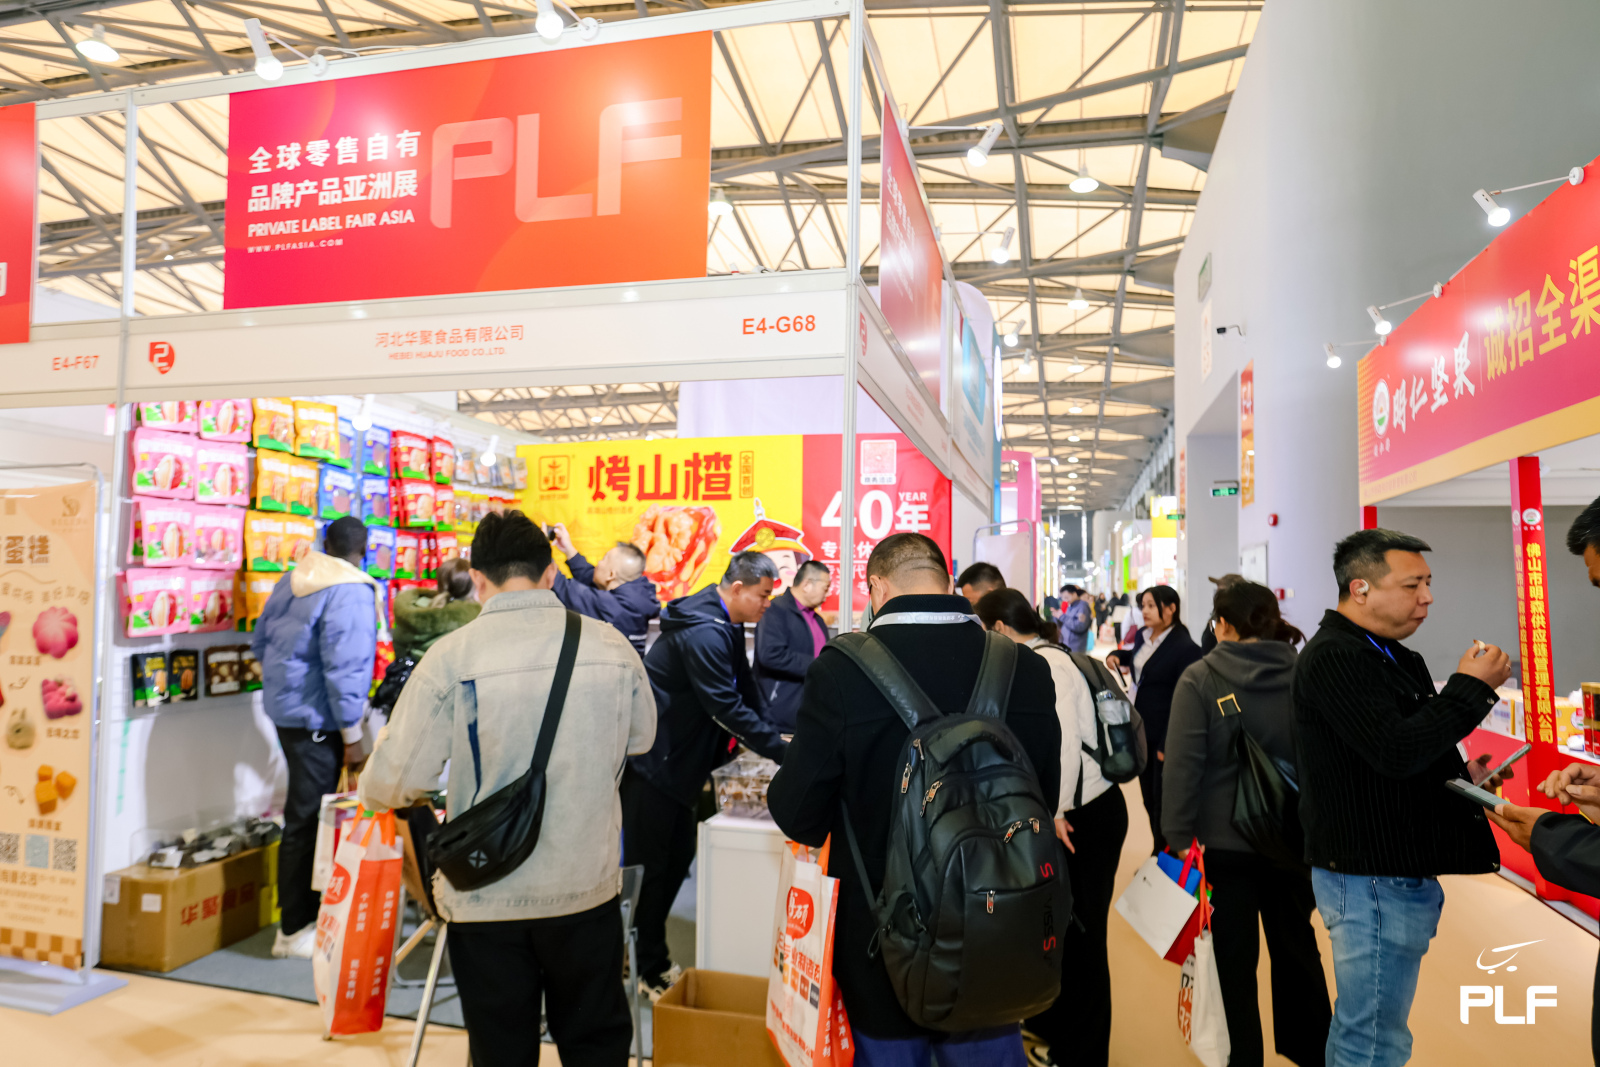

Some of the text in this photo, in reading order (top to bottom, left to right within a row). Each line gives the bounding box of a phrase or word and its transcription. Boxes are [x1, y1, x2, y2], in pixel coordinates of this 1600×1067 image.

[248, 129, 421, 174] 全球零售自有
[430, 97, 683, 229] PLF
[248, 169, 418, 212] 品牌产品亚洲展
[248, 209, 415, 237] PRIVATE LABEL FAIR ASIA
[742, 314, 816, 335] E4-G68
[1484, 245, 1600, 382] 诚招全渠
[375, 324, 524, 348] 河北华聚食品有限公司
[52, 355, 100, 371] E4-F67
[388, 351, 413, 361] HEBEI
[415, 350, 444, 359] HUAJU
[446, 349, 470, 358] FOOD
[588, 451, 732, 502] 烤山楂
[898, 491, 927, 502] YEAR
[1526, 542, 1554, 744] 佛山市明森供应链管理有限公司
